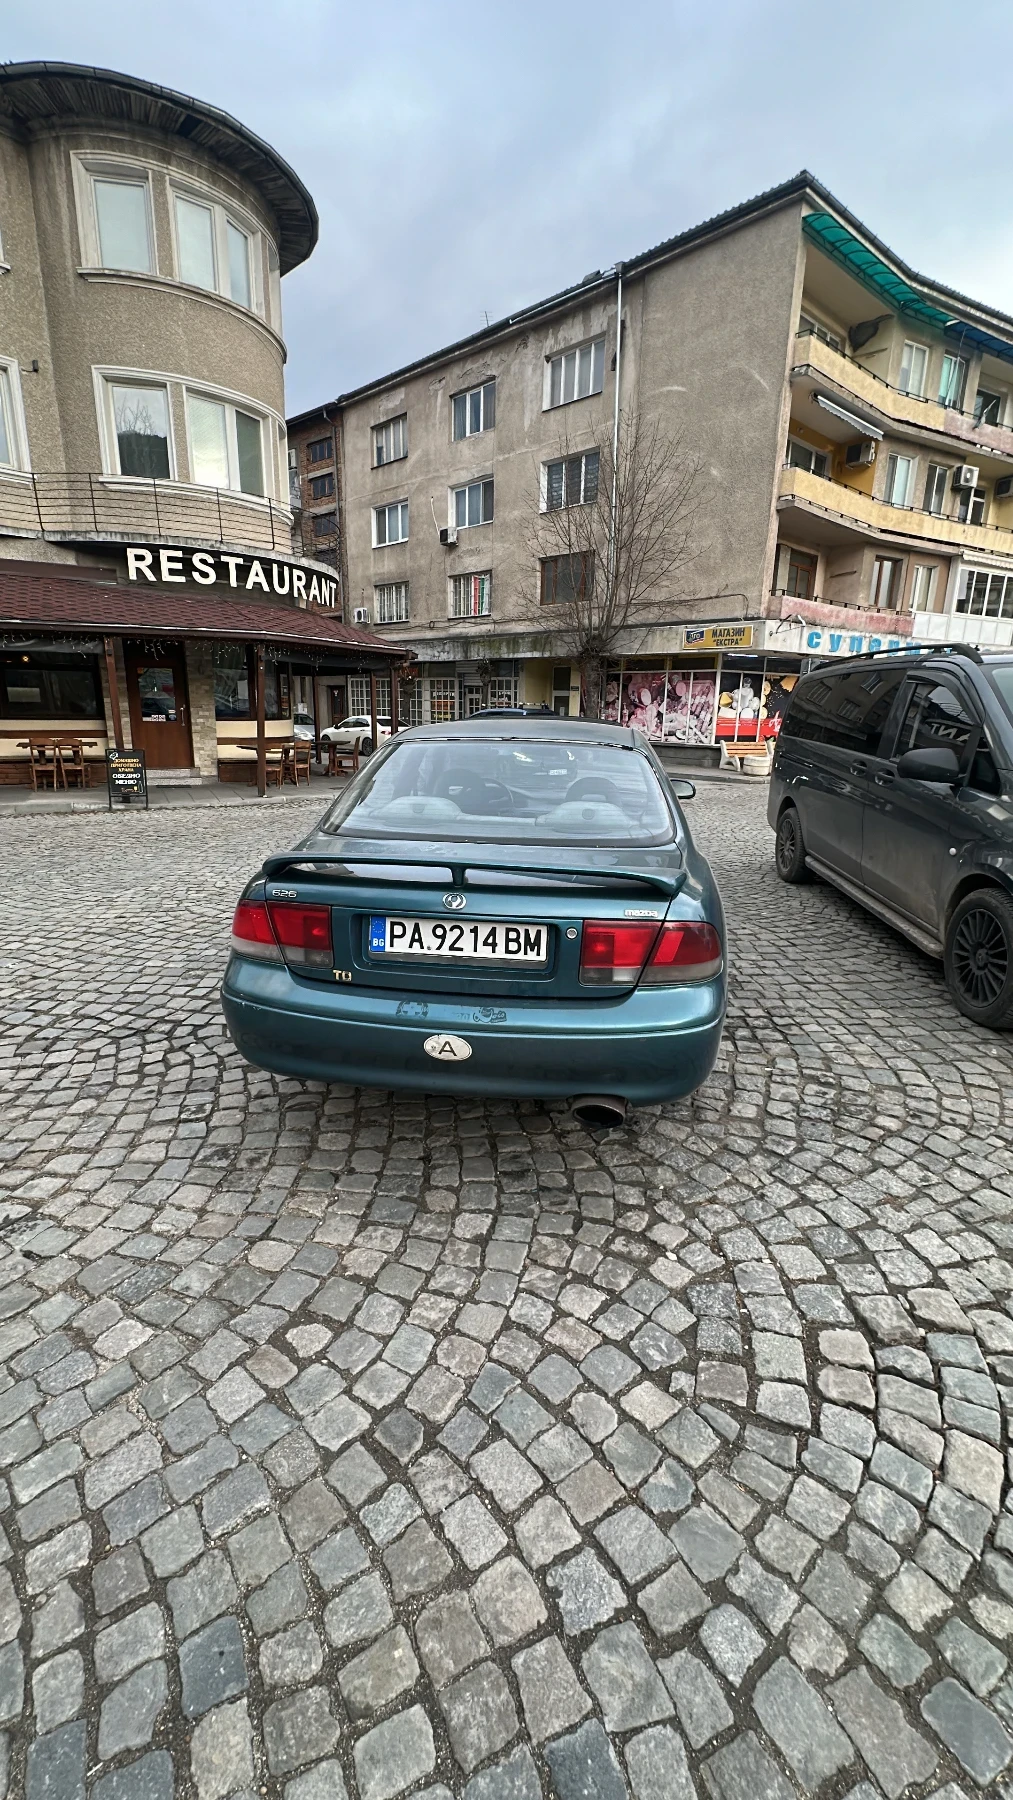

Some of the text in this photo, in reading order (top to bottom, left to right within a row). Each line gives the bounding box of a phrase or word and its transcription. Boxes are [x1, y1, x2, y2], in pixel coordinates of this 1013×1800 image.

[126, 547, 337, 609] RESTAURANT
[711, 627, 745, 639] МАГАЗИН
[272, 889, 298, 898] 626
[372, 938, 385, 947] BG
[438, 1040, 458, 1058] A
